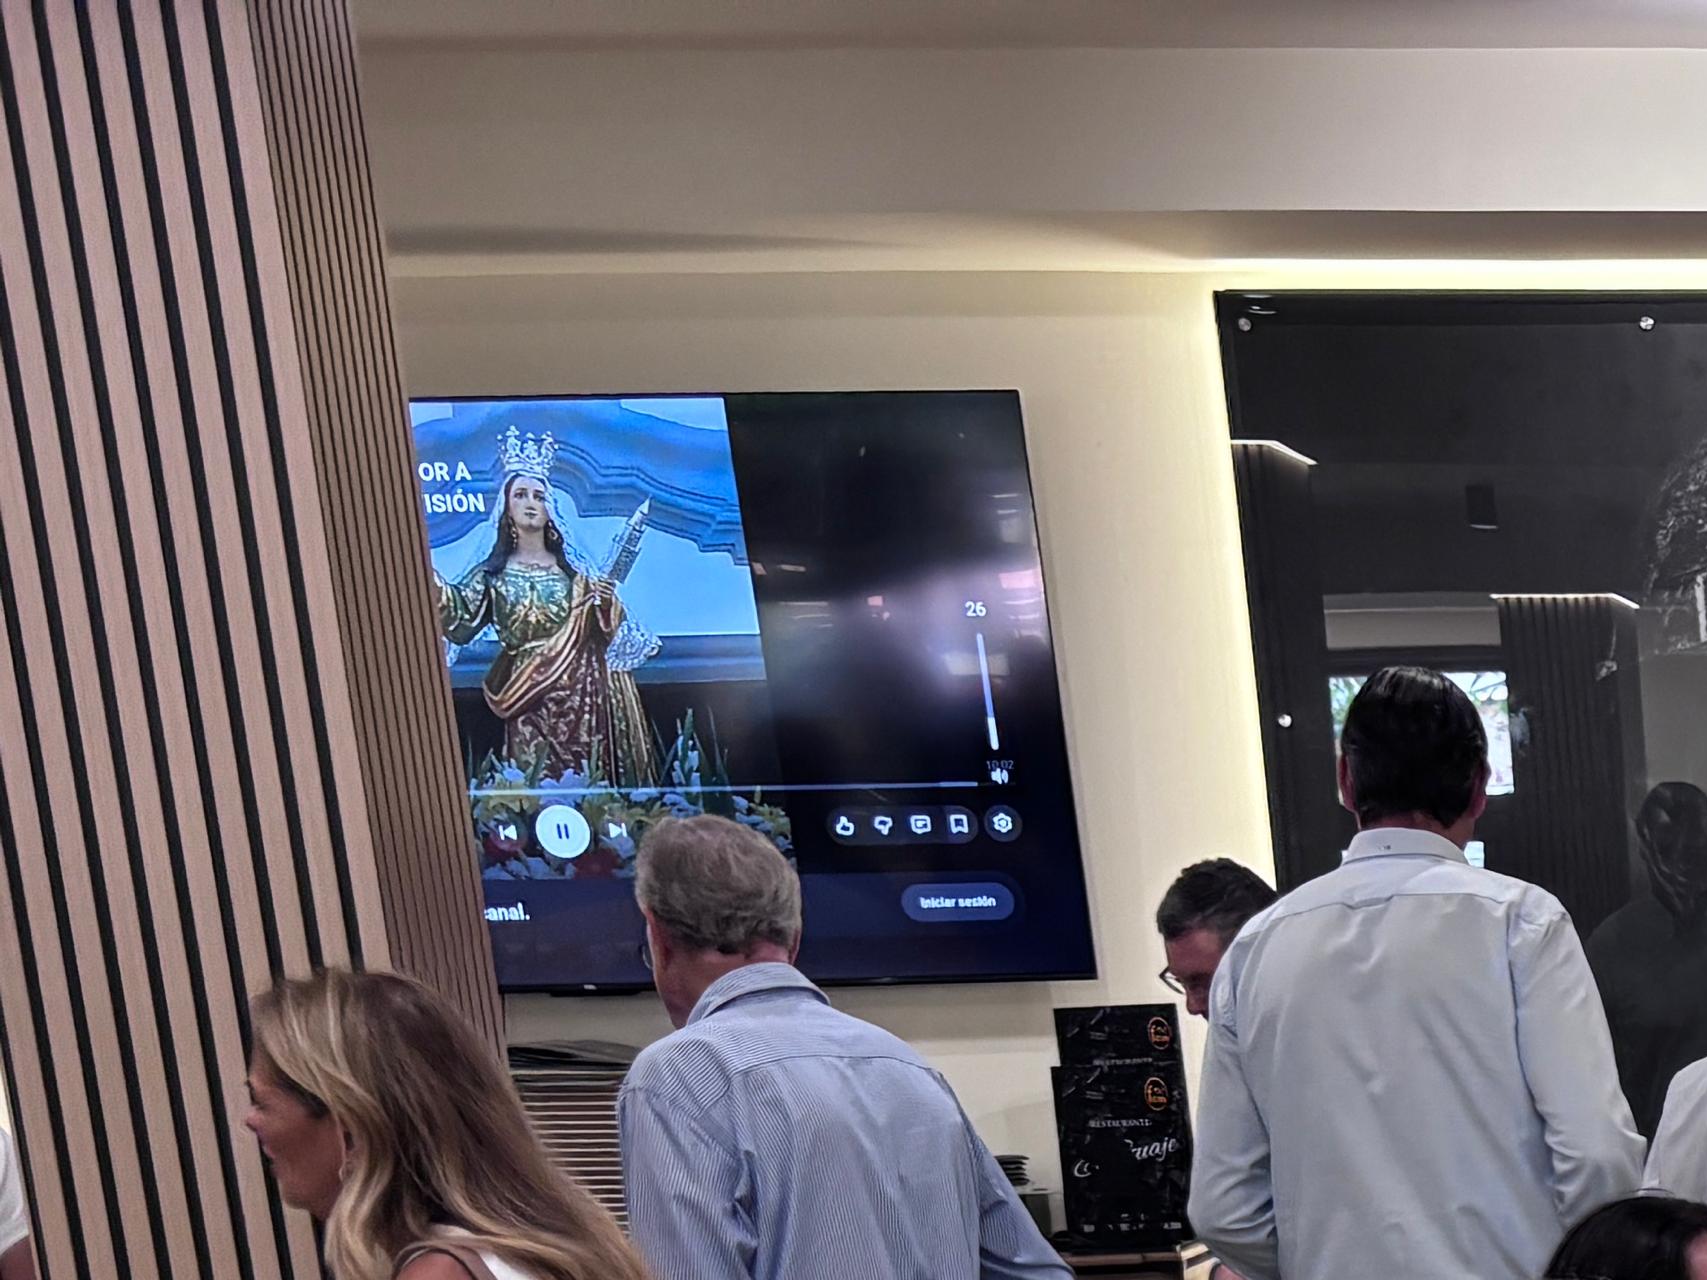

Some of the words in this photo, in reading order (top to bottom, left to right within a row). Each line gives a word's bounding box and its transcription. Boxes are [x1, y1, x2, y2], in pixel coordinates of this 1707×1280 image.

[418, 462, 450, 482] OR
[454, 461, 472, 481] A
[423, 488, 486, 513] ISIÓN
[965, 601, 987, 617] 26
